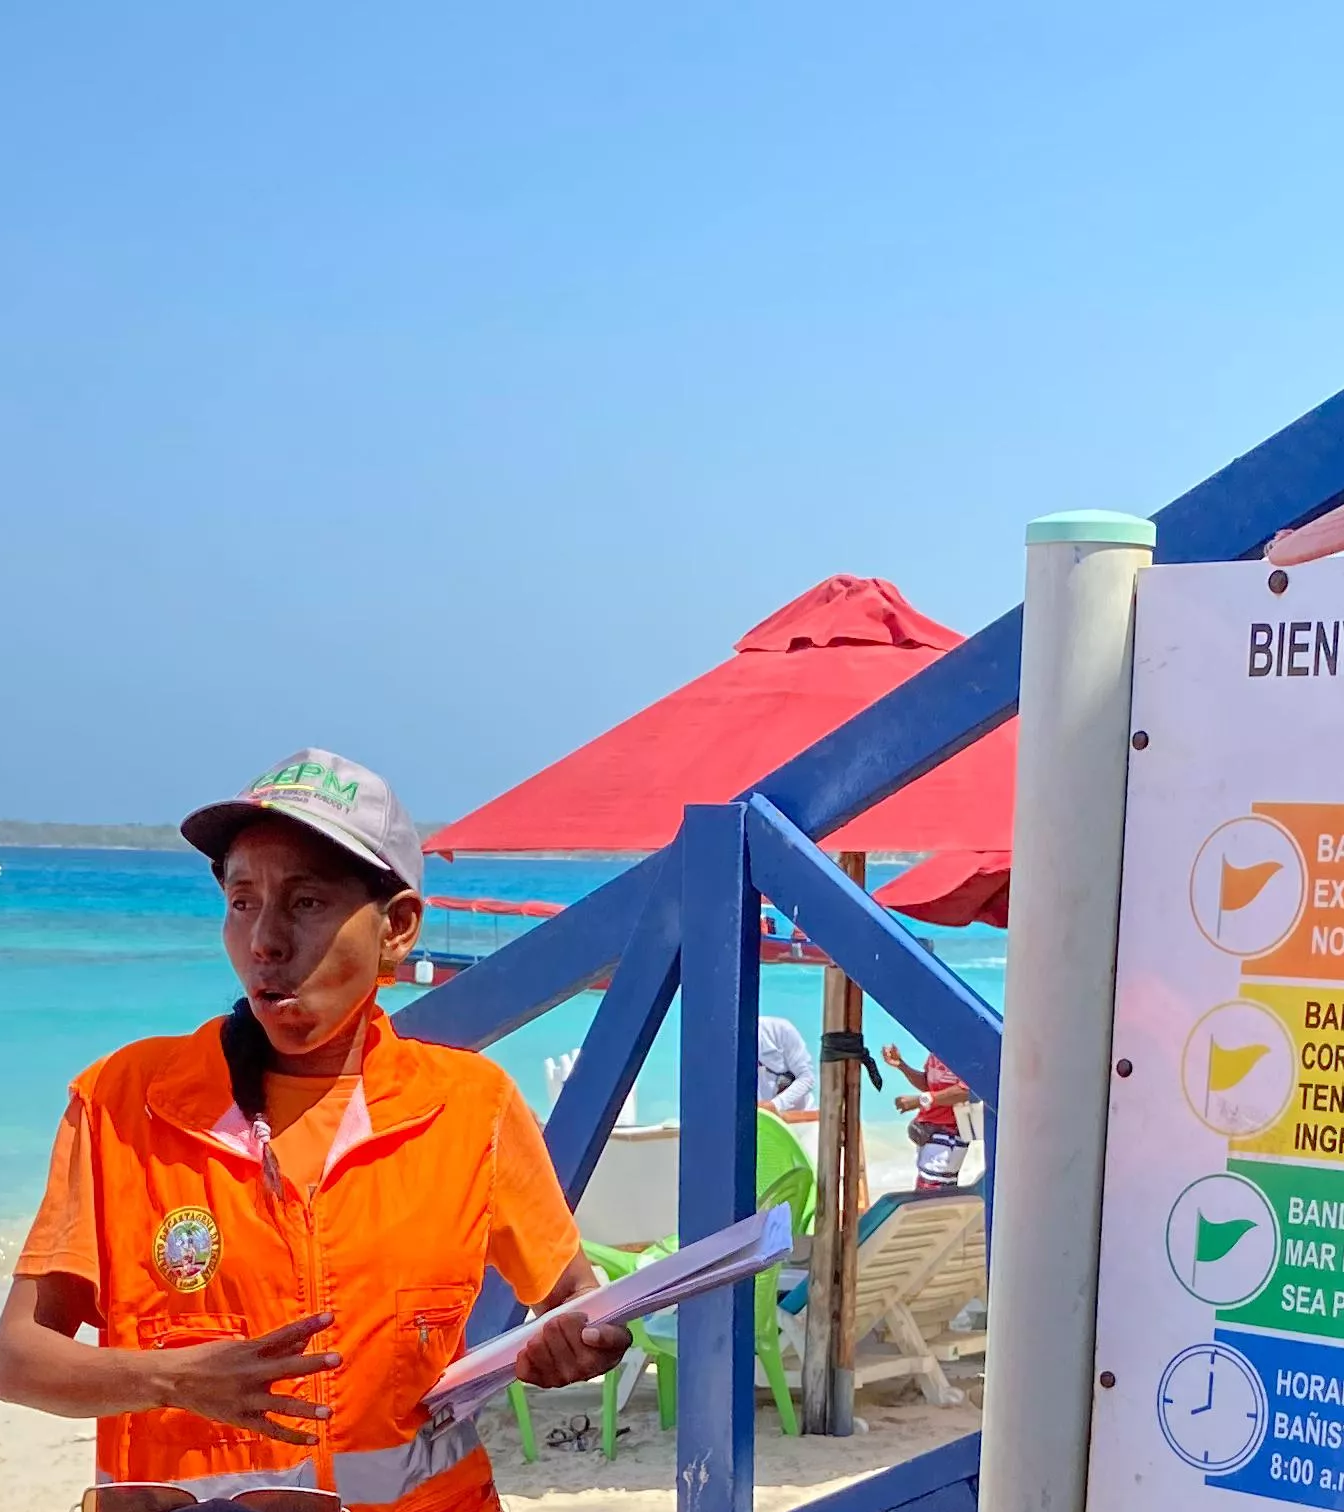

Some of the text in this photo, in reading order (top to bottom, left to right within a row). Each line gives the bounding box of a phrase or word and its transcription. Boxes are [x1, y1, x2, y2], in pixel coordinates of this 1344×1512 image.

[1284, 1239, 1336, 1272] MAR
[1281, 1283, 1327, 1317] SEA
[1270, 1453, 1314, 1486] 8:00
